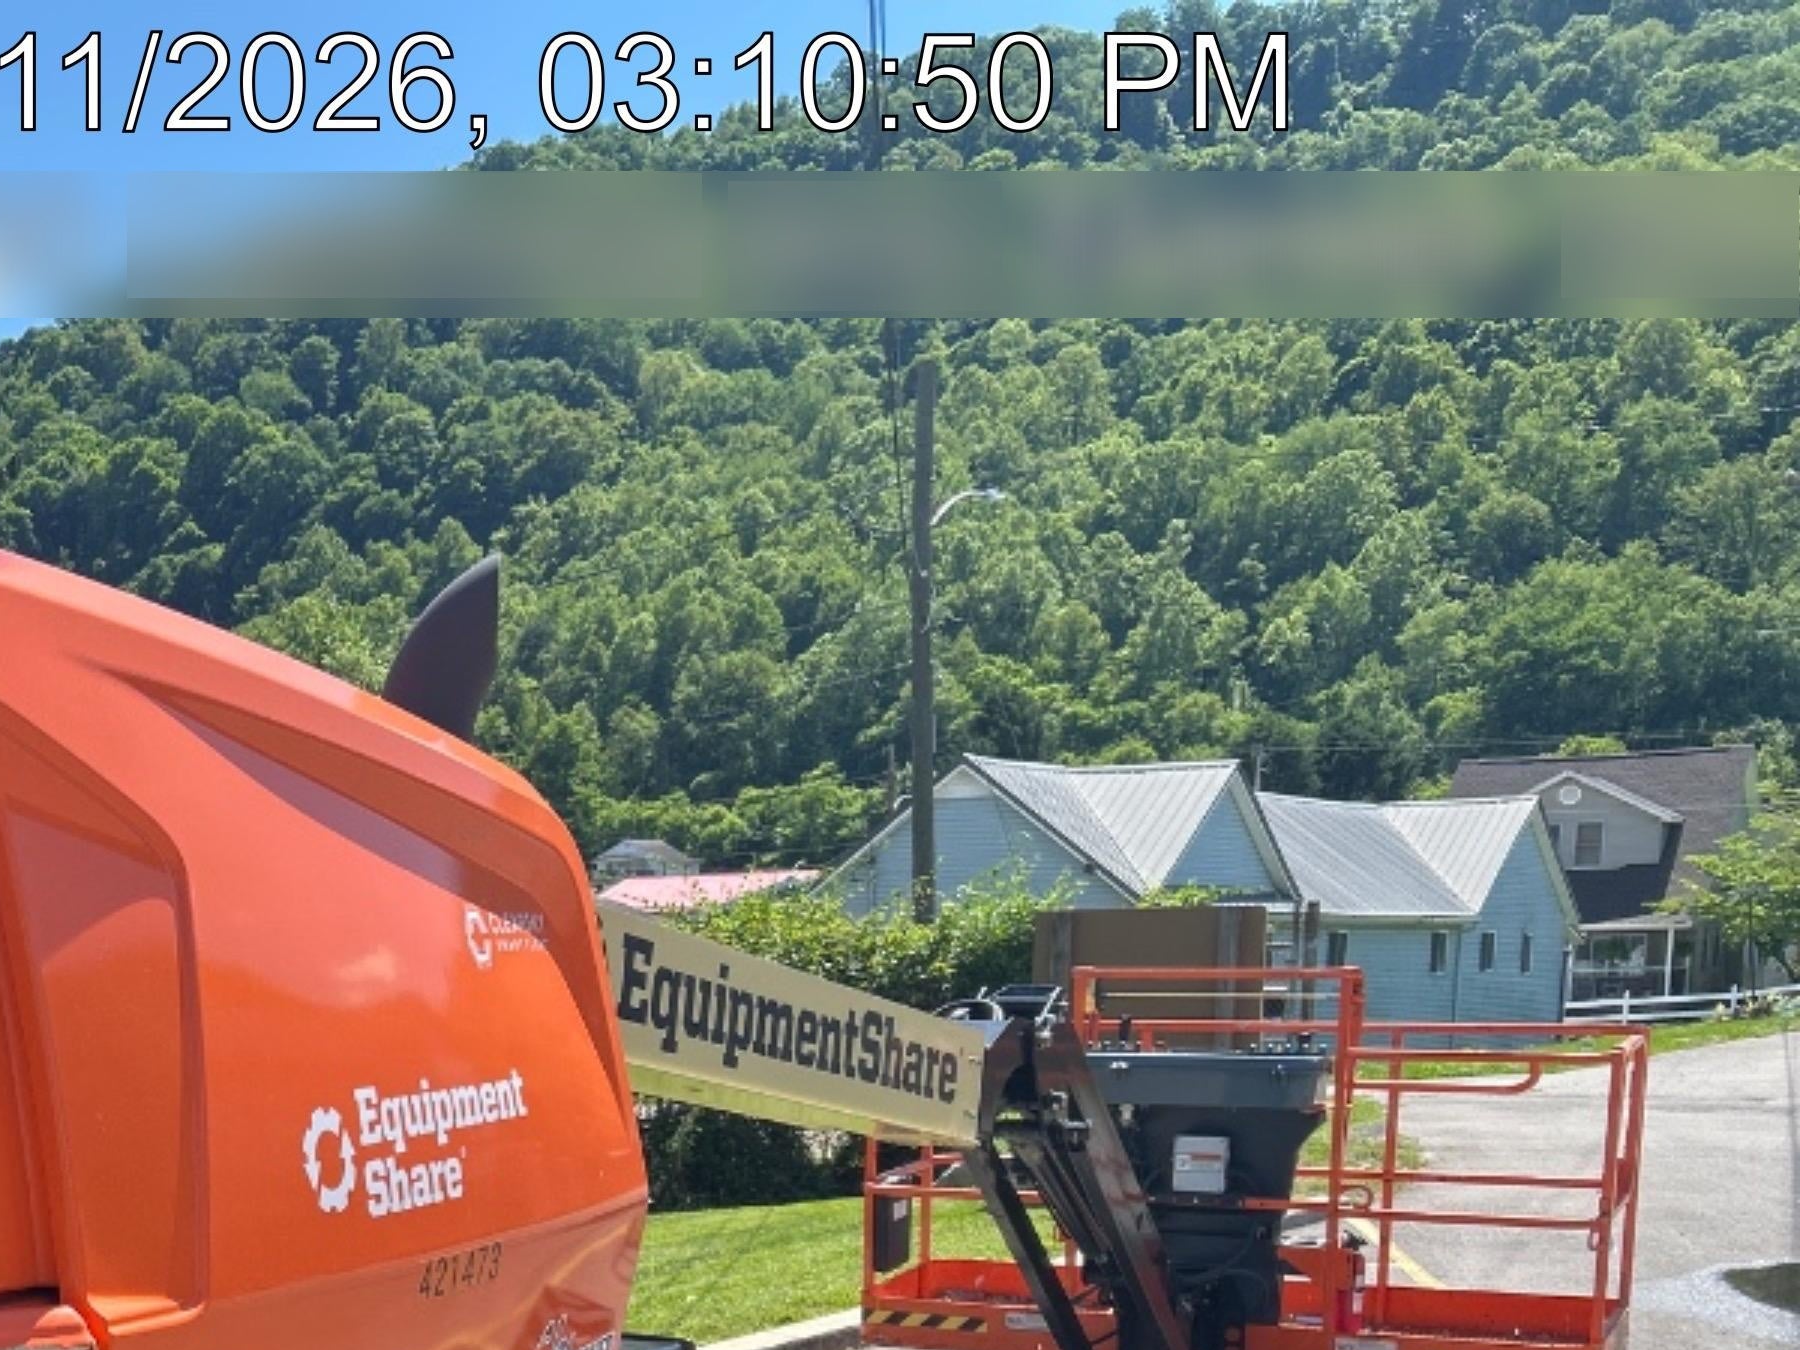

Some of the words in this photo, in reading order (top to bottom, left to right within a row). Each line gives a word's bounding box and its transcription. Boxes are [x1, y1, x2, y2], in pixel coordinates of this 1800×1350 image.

[617, 932, 958, 1105] EquipmentShare
[353, 1067, 528, 1153] Equipment
[364, 1155, 464, 1219] Share
[418, 1241, 502, 1299] 421473
